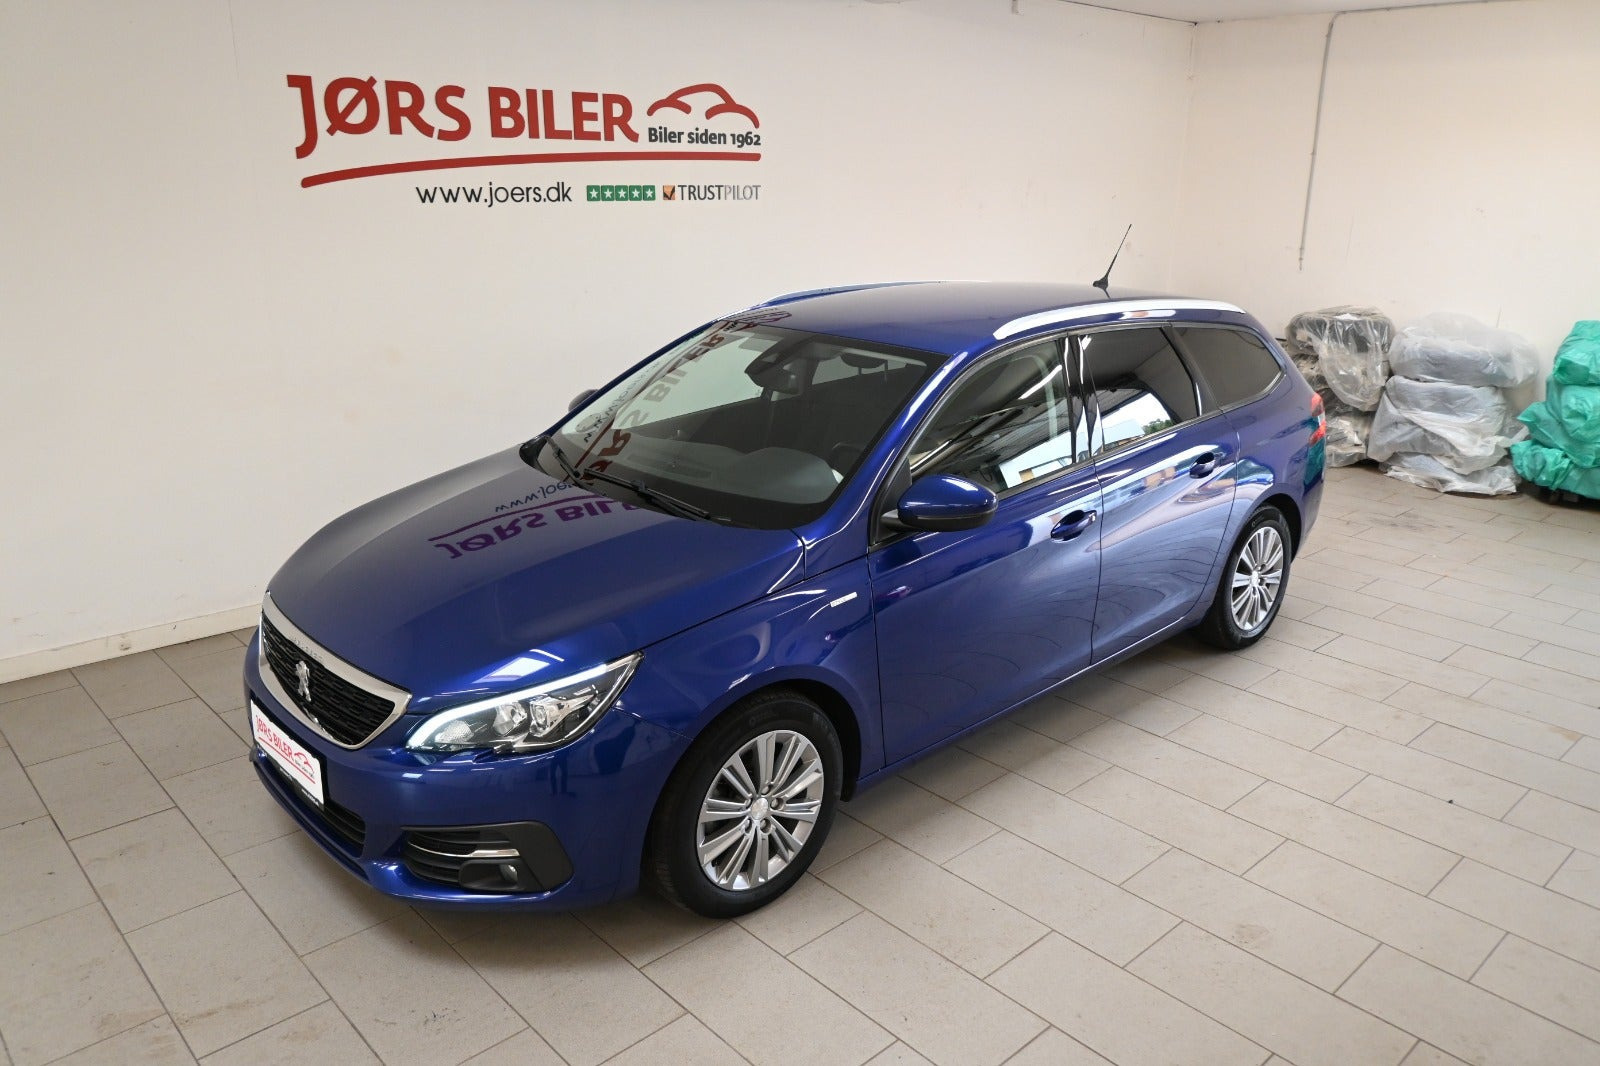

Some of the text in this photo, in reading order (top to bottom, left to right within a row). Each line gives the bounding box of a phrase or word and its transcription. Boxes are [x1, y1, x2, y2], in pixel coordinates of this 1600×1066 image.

[286, 74, 640, 160] JØRS BILER
[648, 127, 762, 148] Biler siden 1962
[415, 181, 573, 208] www.joers.dk
[678, 184, 762, 201] TRUSTPILOT
